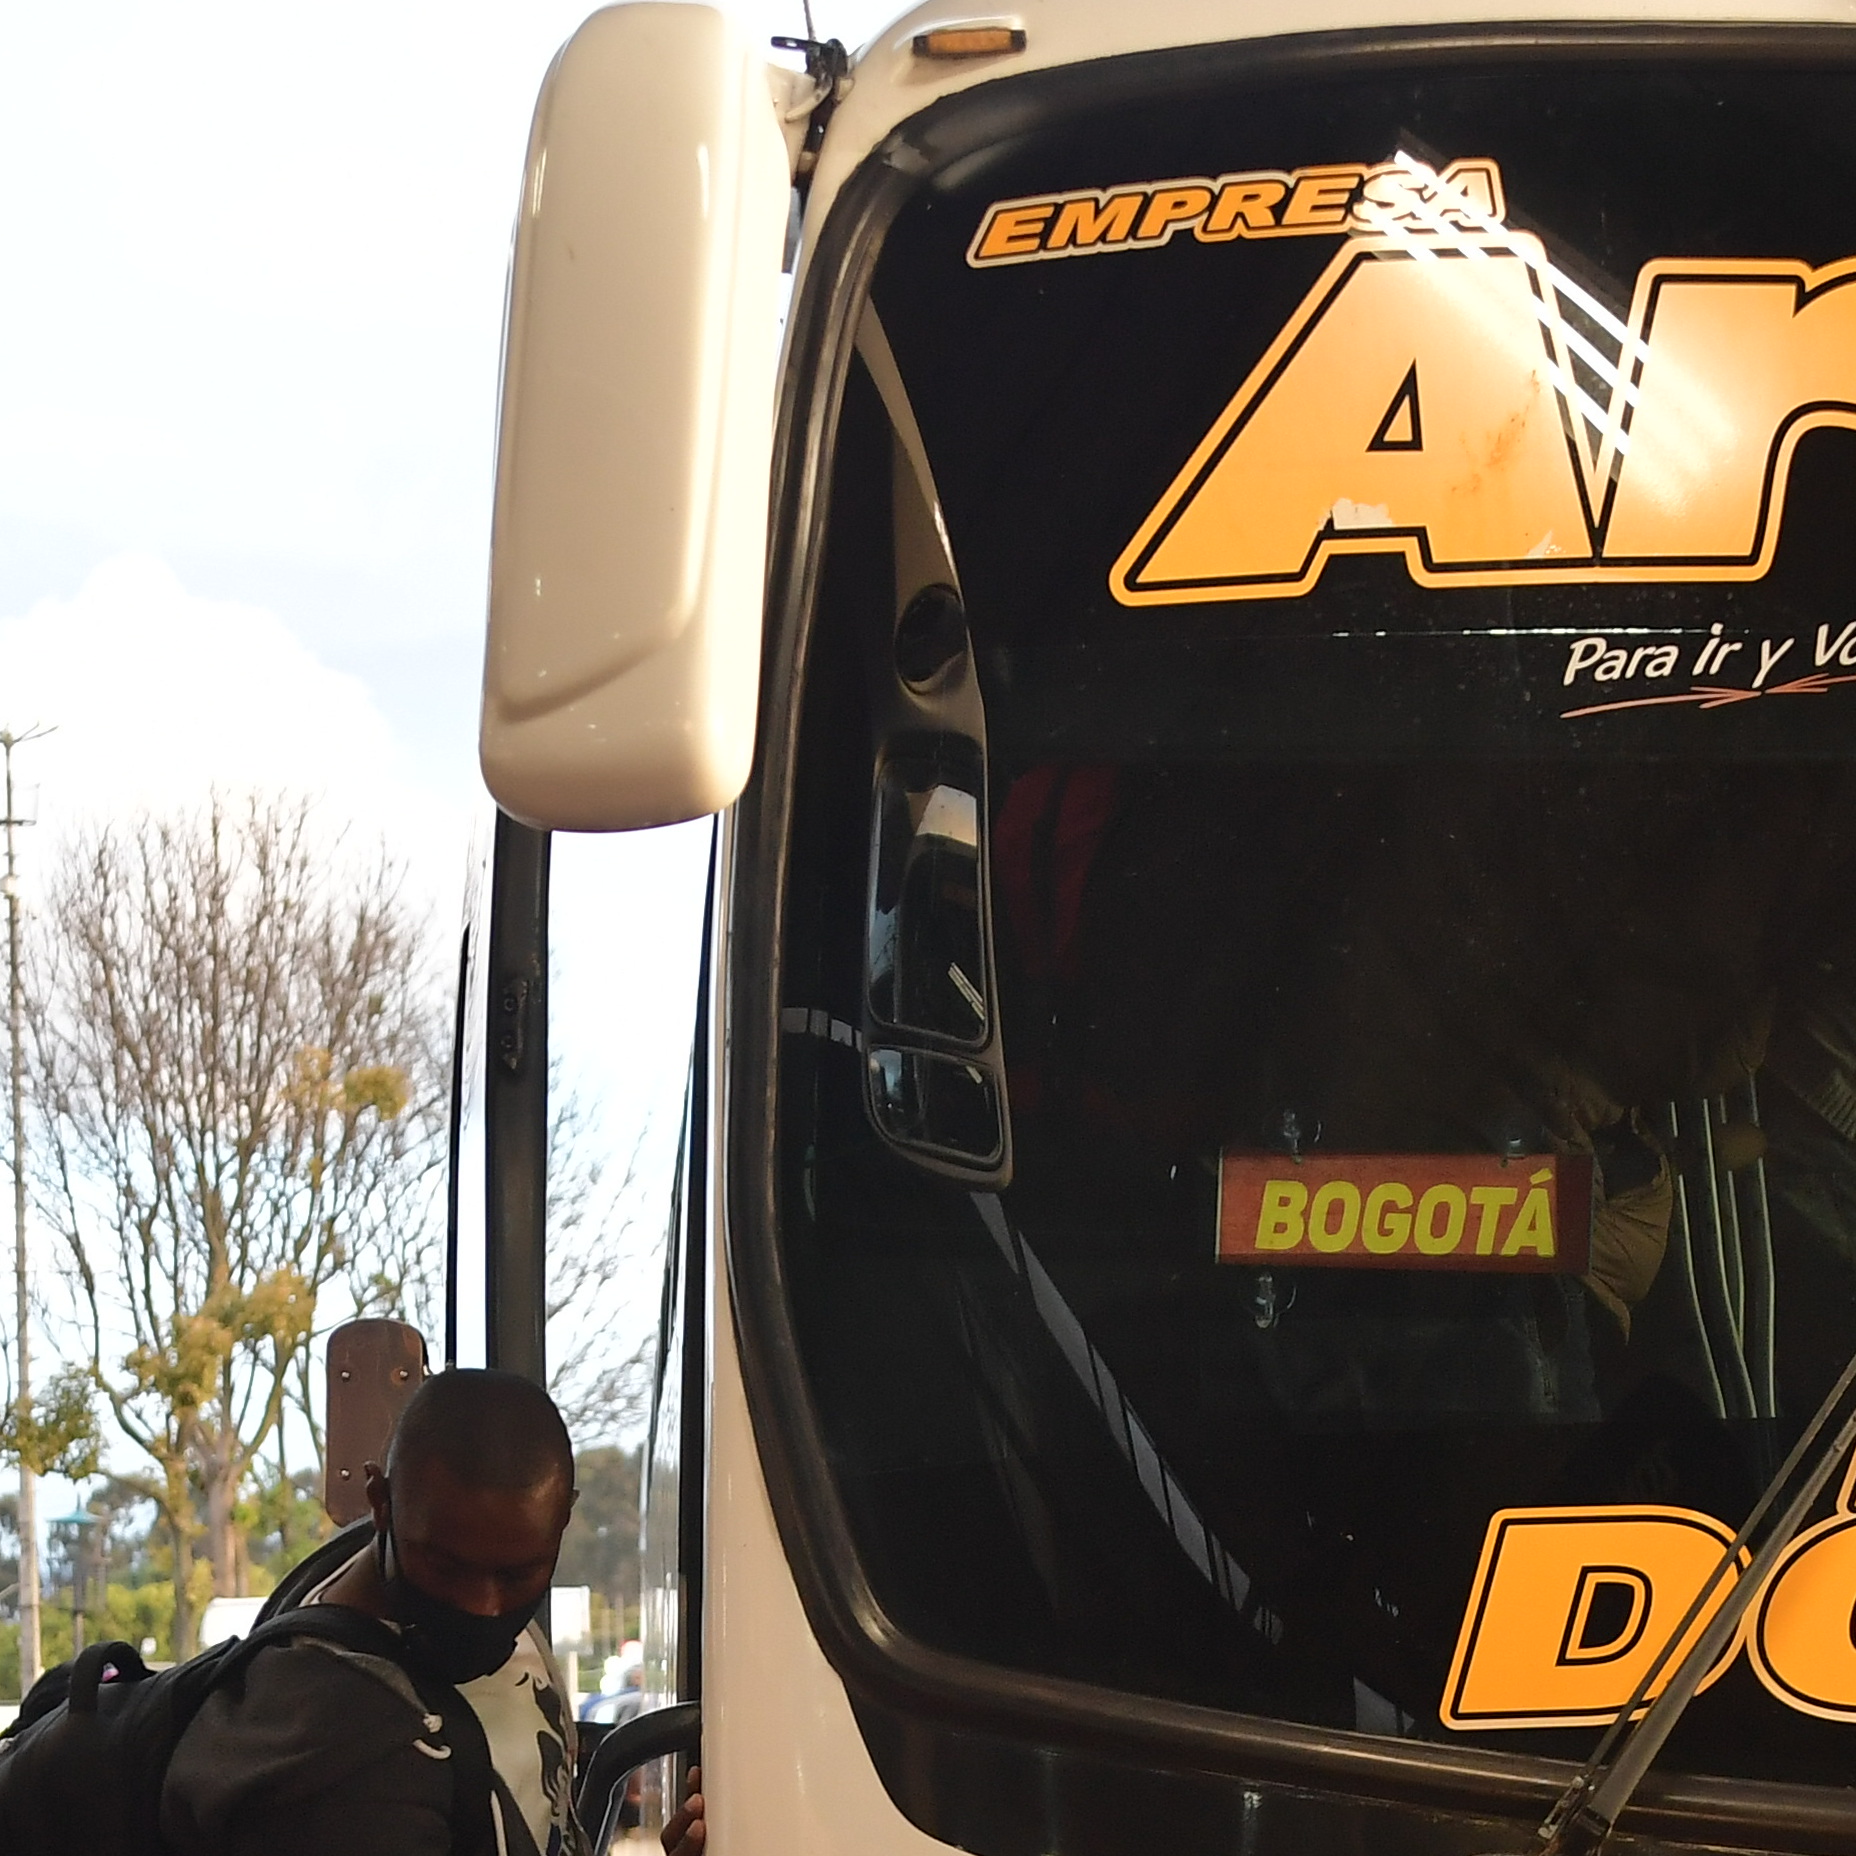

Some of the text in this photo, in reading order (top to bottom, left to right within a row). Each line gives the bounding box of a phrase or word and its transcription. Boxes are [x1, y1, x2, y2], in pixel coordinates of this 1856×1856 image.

[966, 158, 1506, 269] EMPRESA
[1562, 637, 1679, 687] Para
[1691, 622, 1741, 677] ir
[1751, 636, 1794, 690] y
[1254, 1167, 1555, 1257] BOGOTÁ
